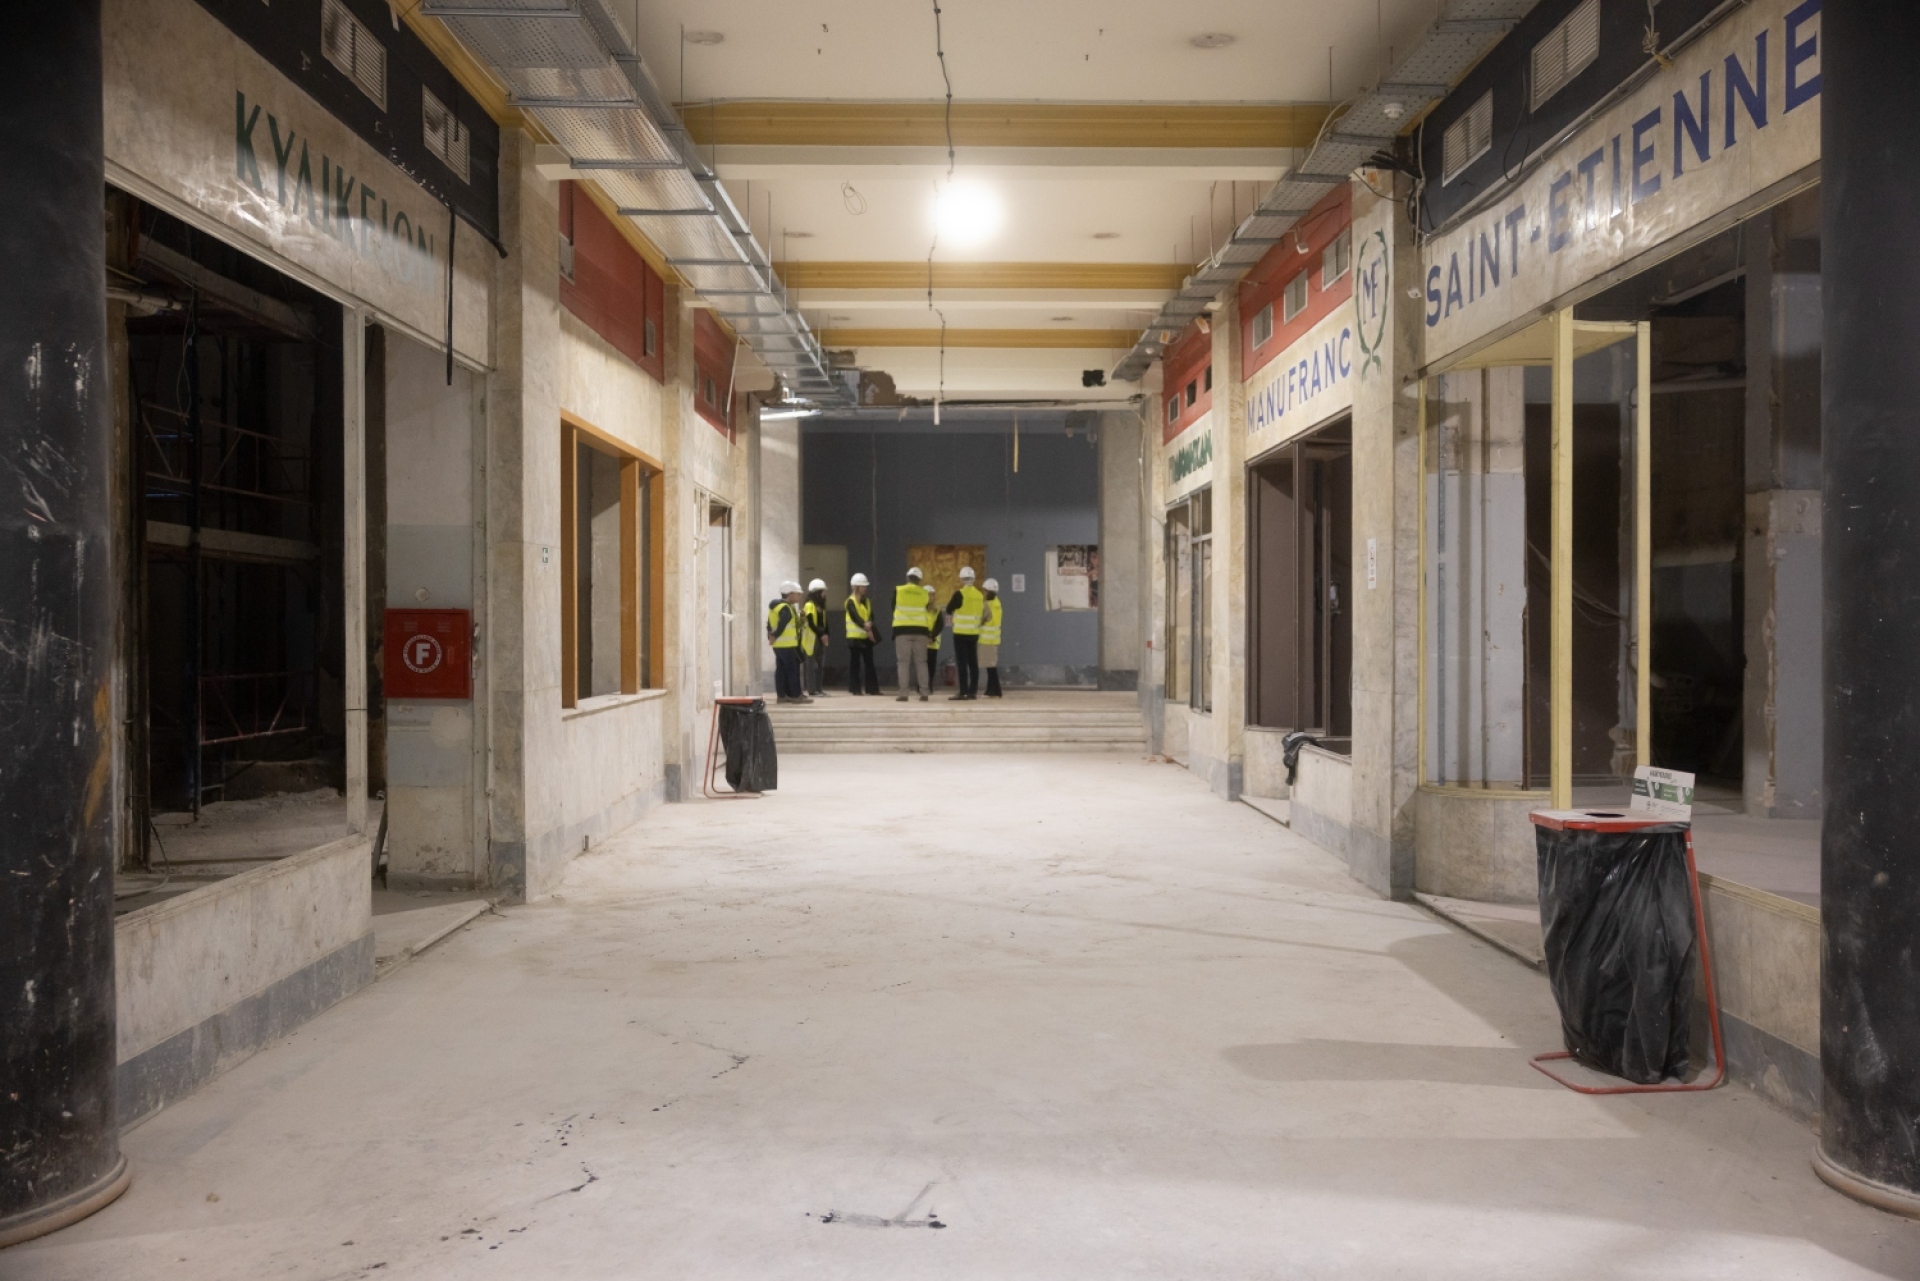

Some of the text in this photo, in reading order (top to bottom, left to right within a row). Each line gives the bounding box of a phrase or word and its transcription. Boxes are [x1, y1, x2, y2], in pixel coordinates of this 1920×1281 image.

[1426, 4, 1822, 328] SAINT-ETIENNE
[1246, 326, 1352, 437] MANUFRANC
[416, 643, 431, 665] F
